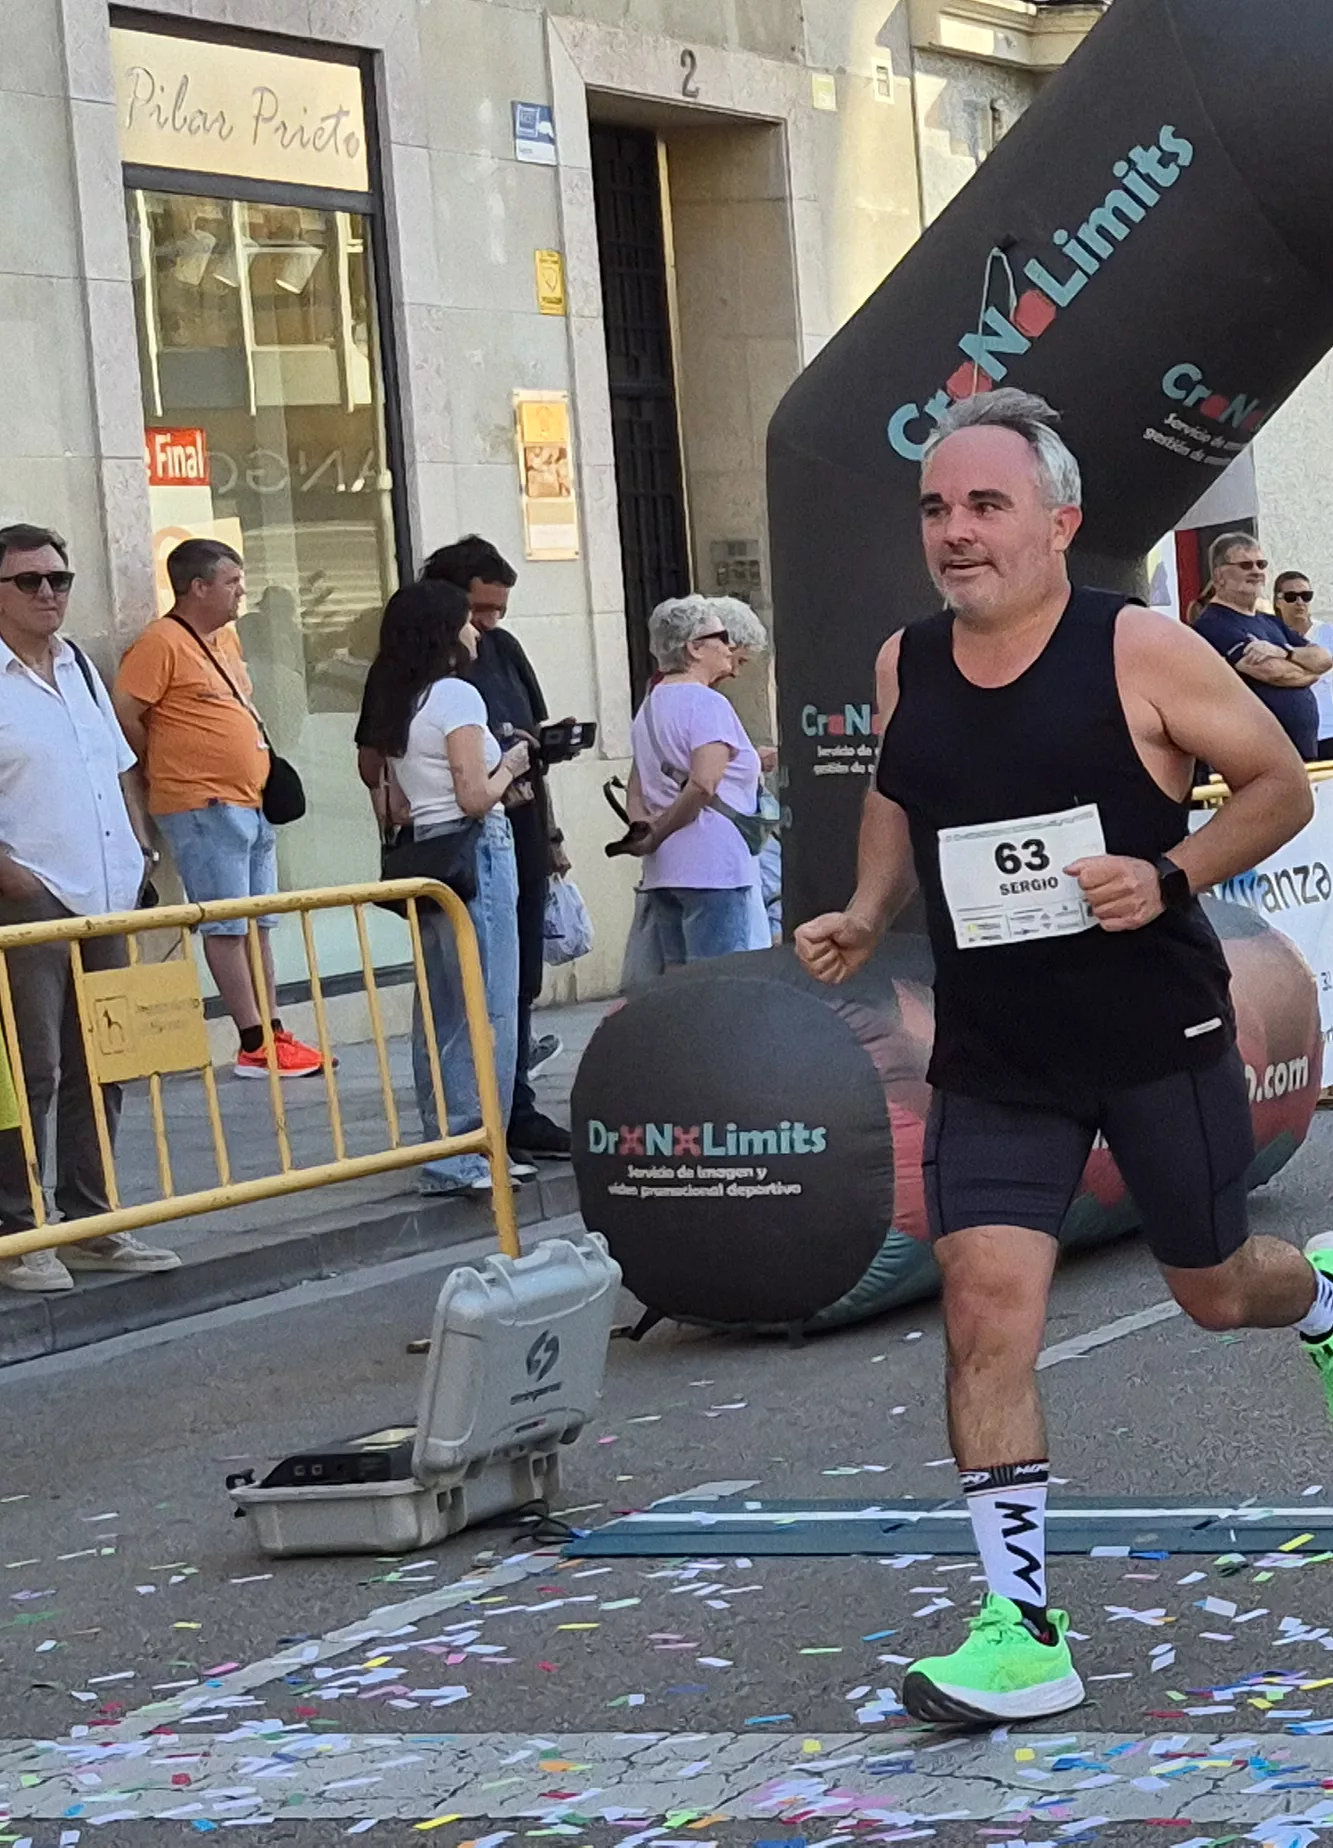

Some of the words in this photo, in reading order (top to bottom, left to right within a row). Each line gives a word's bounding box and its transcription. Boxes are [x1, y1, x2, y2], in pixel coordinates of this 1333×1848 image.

[680, 48, 700, 98] 2
[126, 66, 235, 142] Pilar
[250, 85, 362, 159] Prieto
[155, 430, 205, 478] Final
[994, 838, 1050, 875] 63
[999, 876, 1059, 896] SERGIO
[726, 1180, 802, 1199] deportivo
